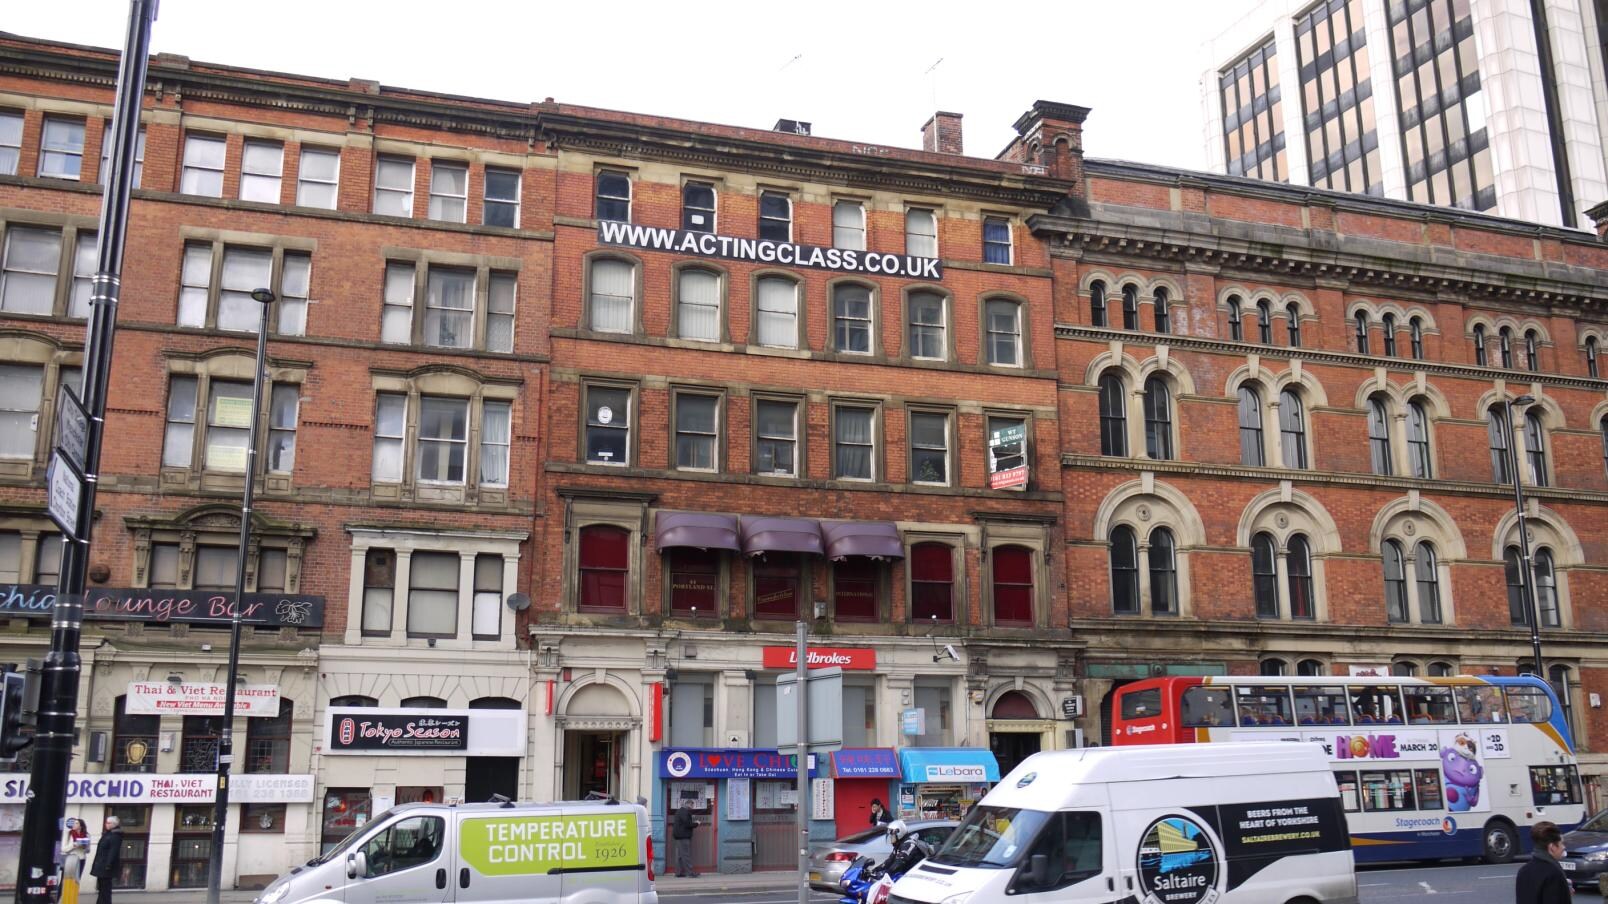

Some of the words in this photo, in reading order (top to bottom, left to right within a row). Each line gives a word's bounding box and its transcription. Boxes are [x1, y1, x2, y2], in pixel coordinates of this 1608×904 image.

[601, 221, 941, 280] WWW.ACTINGCLASS.CO.UK
[1001, 433, 1023, 442] GUNSON
[789, 651, 852, 664] Ldbrokes
[135, 685, 163, 695] Thai
[167, 685, 176, 695] &
[181, 685, 206, 695] Viet
[210, 686, 277, 697] Reaurant
[360, 721, 403, 744] Tokyo
[403, 722, 460, 738] Season
[1491, 734, 1501, 742] 2D
[1336, 734, 1400, 759] HOME
[1400, 743, 1426, 751] MARCH
[1429, 743, 1437, 751] 20
[1494, 743, 1504, 751] 3D
[939, 767, 983, 776] Lebara
[66, 779, 144, 798] ORCHID
[152, 779, 174, 788] THAI
[180, 779, 203, 788] VIET
[229, 779, 252, 788] ULLY
[256, 779, 309, 788] LICENSED
[150, 789, 214, 798] RESTAURANT
[229, 789, 248, 798] 161
[1247, 809, 1271, 818] BEERS
[1272, 808, 1293, 816] FROM
[1294, 806, 1309, 814] THE
[1239, 819, 1264, 829] HEART
[1265, 819, 1276, 827] OF
[1277, 815, 1319, 826] YORKSHIRE
[1395, 817, 1441, 829] Stagecoach
[486, 820, 628, 842] TEMPERATURE
[489, 842, 586, 863] CONTROL
[595, 843, 627, 862] 1926
[1154, 873, 1206, 890] Saltaire
[1165, 891, 1198, 901] BREWERY
